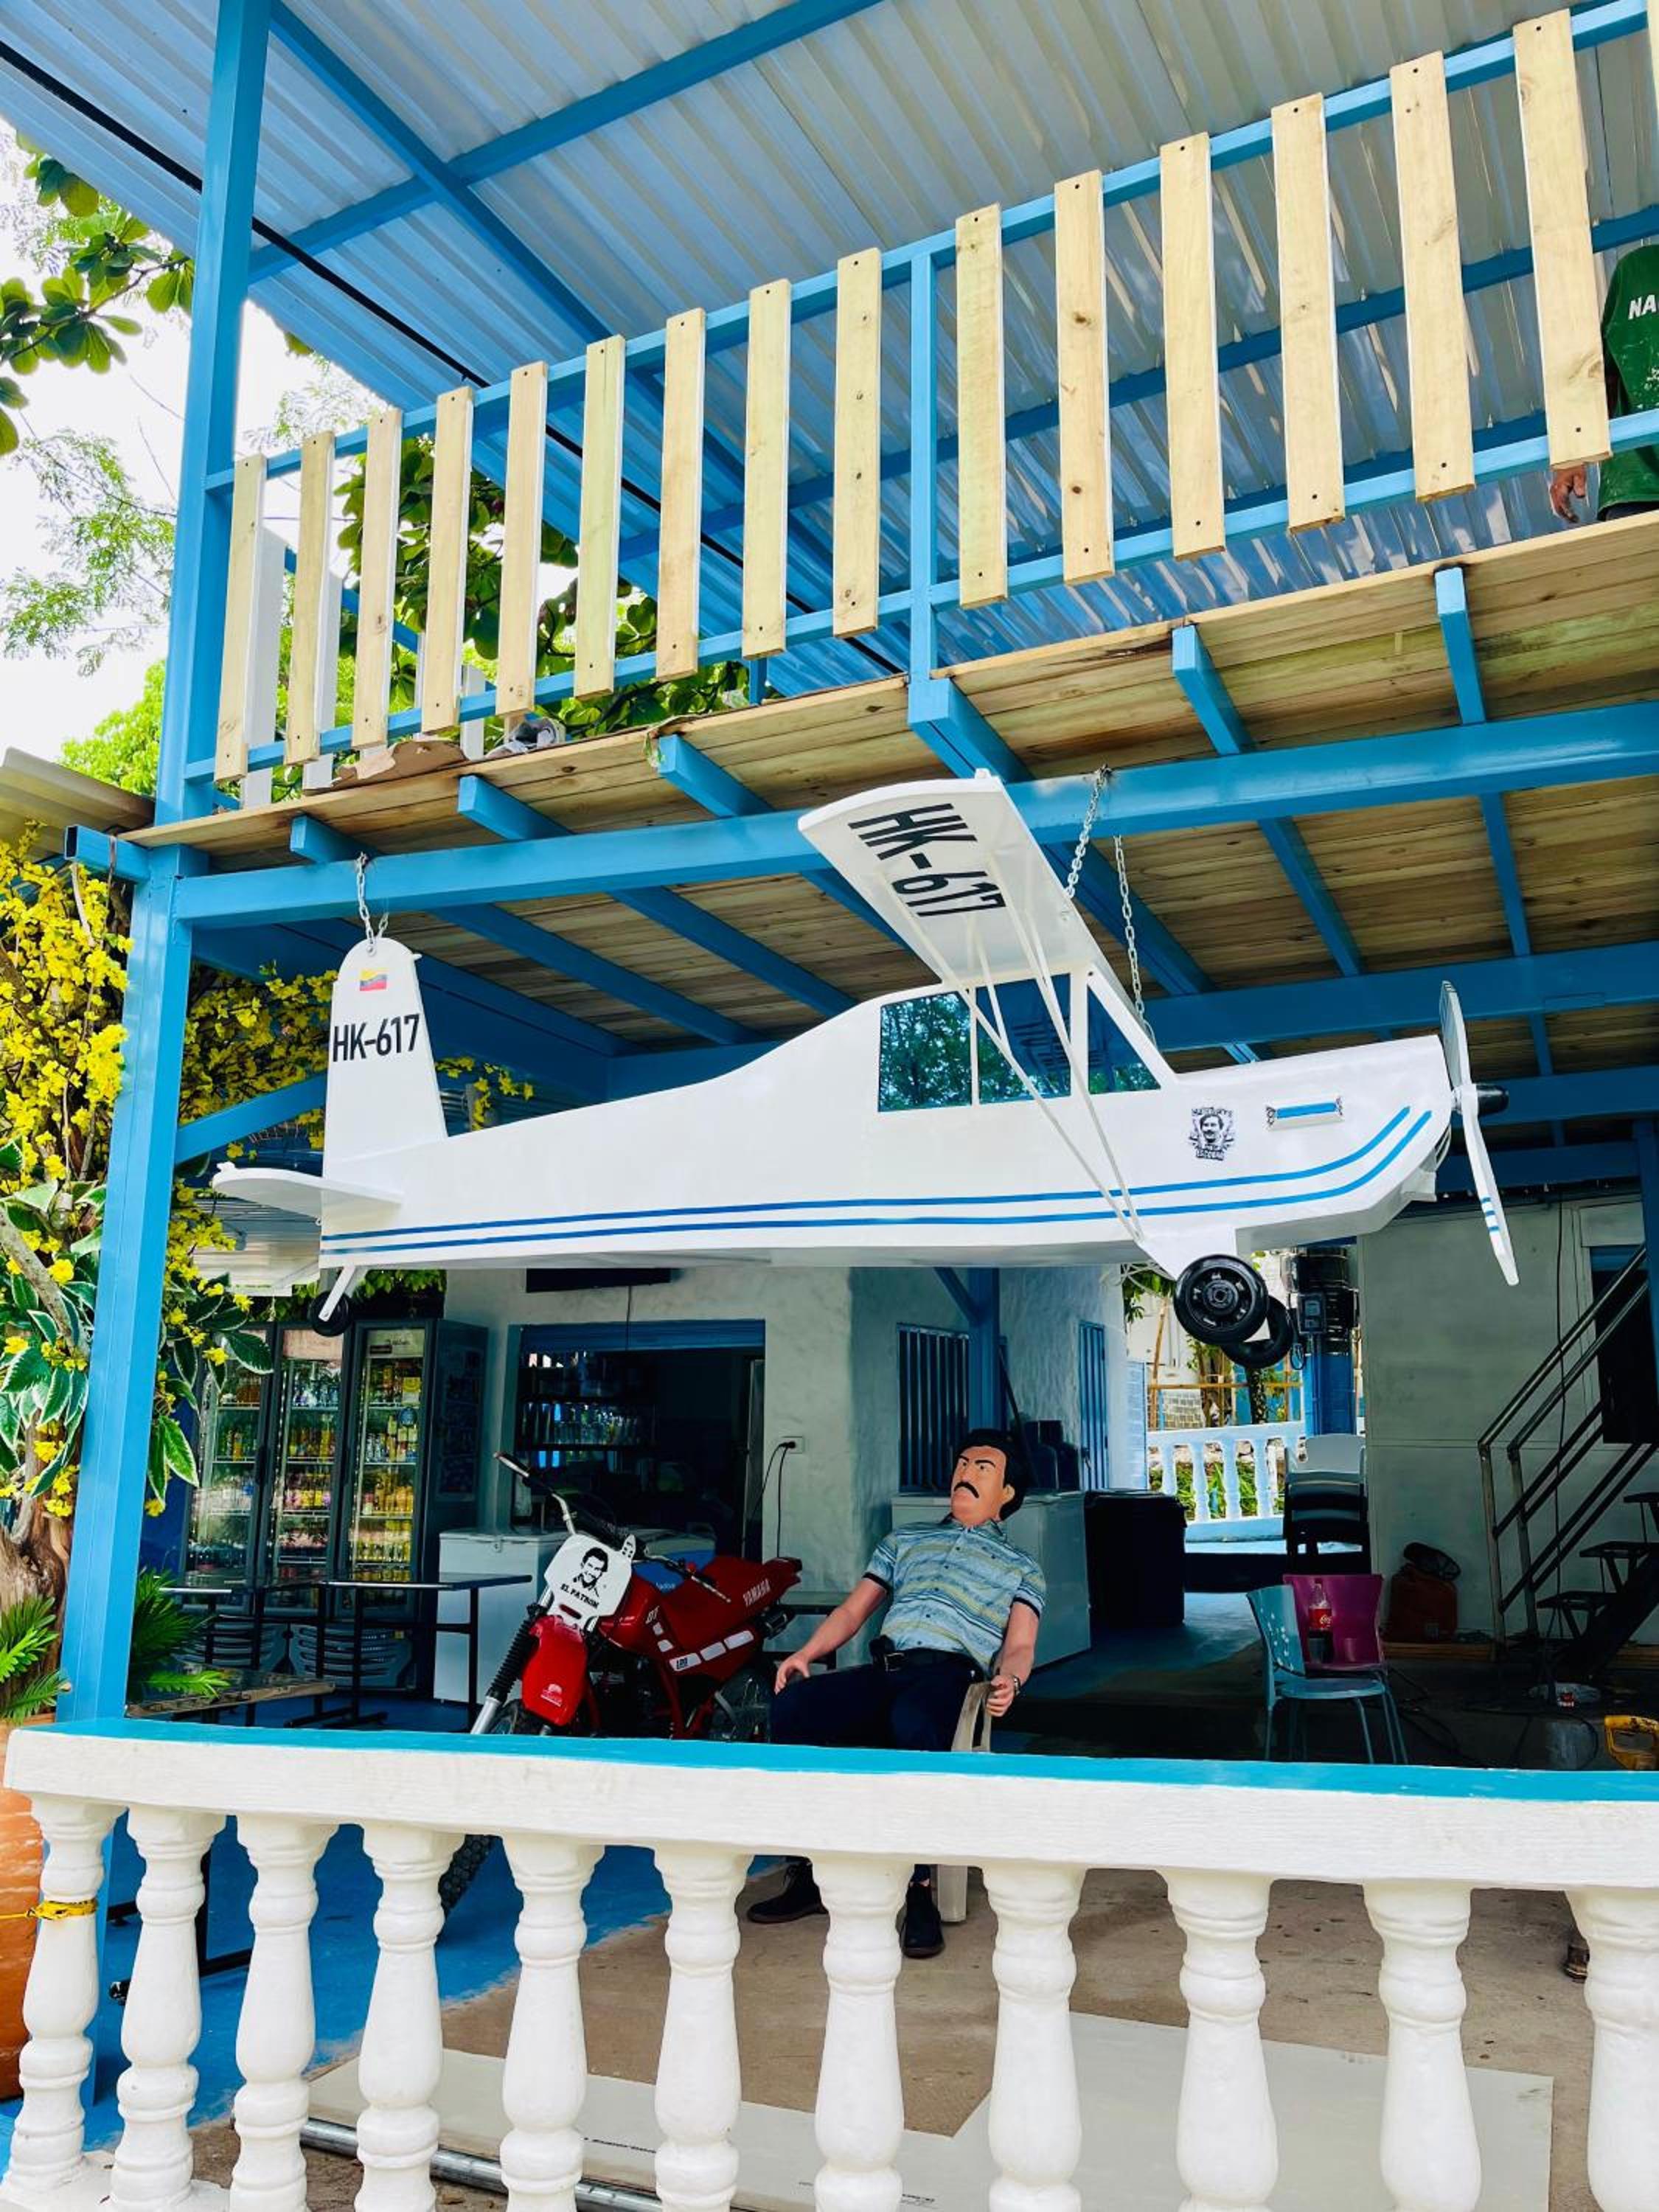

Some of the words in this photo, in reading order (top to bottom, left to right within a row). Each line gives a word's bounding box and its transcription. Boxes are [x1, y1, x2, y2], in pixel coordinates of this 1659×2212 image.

[1628, 294, 1659, 320] NA
[847, 802, 1006, 918] HK-617
[333, 1013, 420, 1062] HK-617
[560, 1583, 569, 1593] EL
